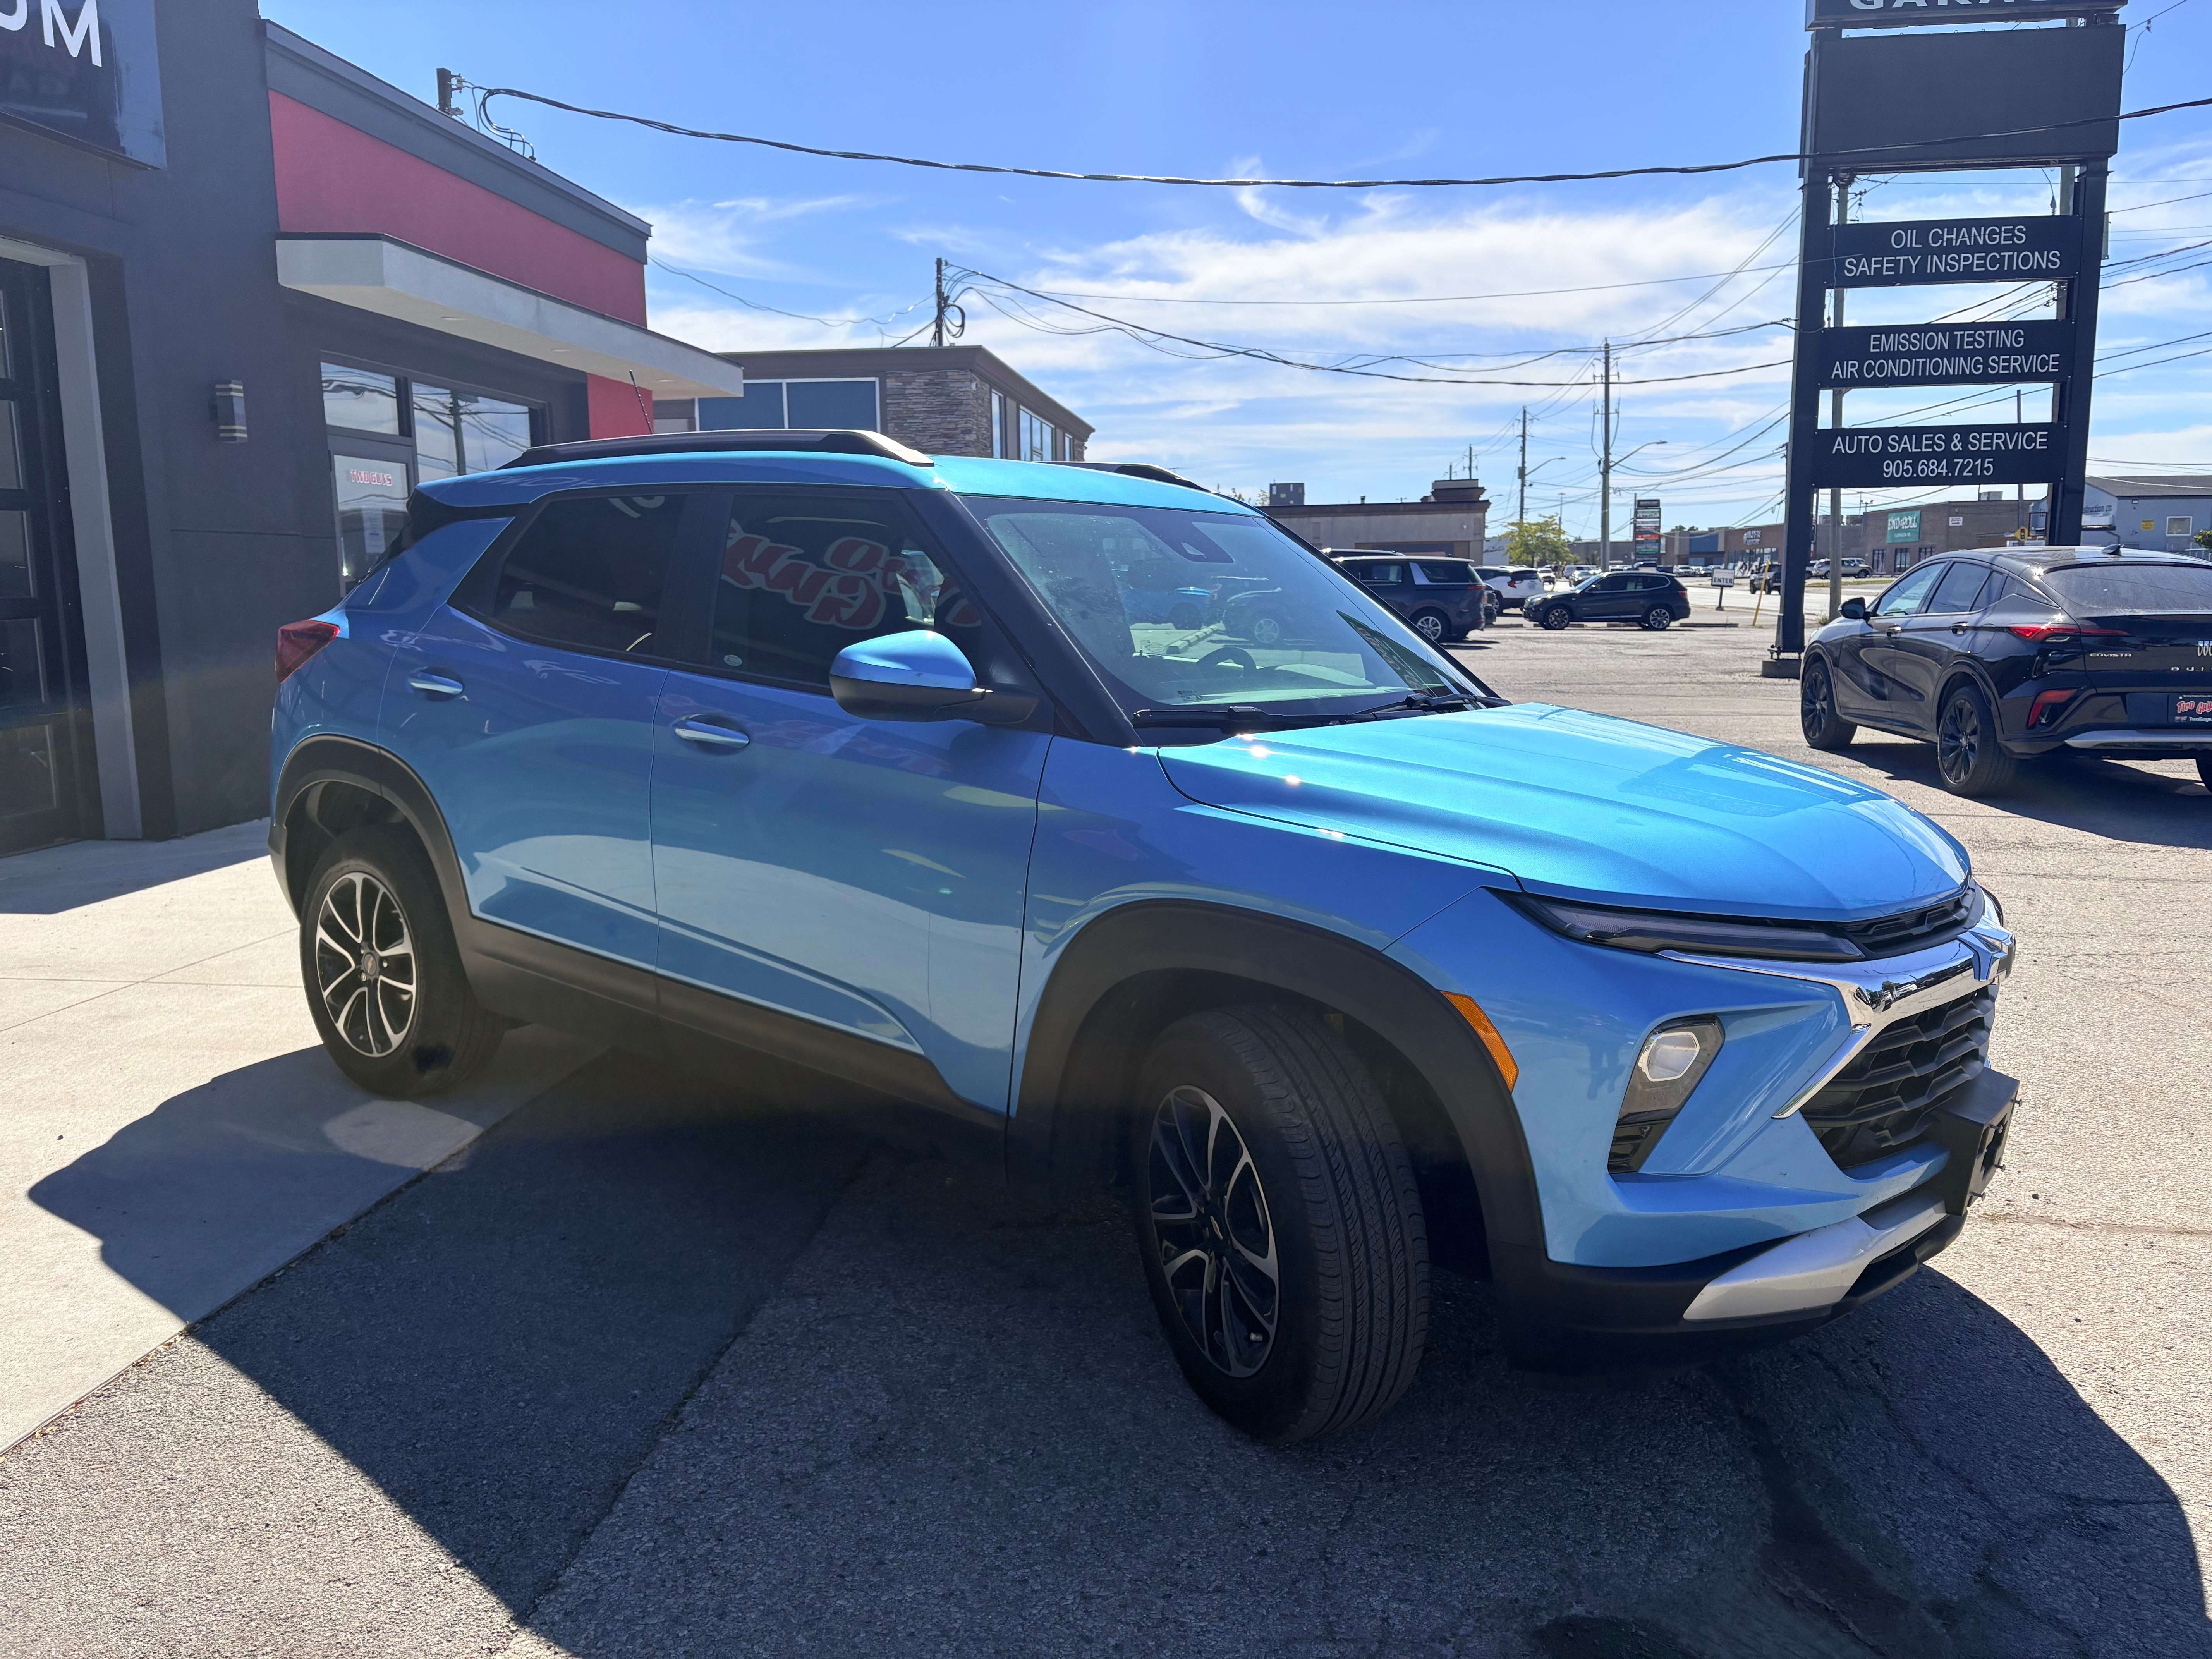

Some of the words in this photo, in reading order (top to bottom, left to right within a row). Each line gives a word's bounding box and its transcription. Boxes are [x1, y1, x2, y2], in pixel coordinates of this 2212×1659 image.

[1891, 230, 1922, 248] OIL
[1929, 225, 2026, 247] CHANGES
[1844, 255, 1921, 276] SAFETY
[1927, 251, 2061, 273] INSPECTIONS
[1870, 331, 1949, 352] EMISSION
[1954, 329, 2024, 349] TESTING
[1831, 360, 1859, 379] AIR
[1864, 357, 1983, 378] CONDITIONING
[1988, 354, 2060, 374] SERVICE
[1832, 435, 1882, 453] AUTO
[1887, 433, 1945, 452] SALES
[1951, 433, 1962, 451] &
[1968, 431, 2048, 450] SERVICE
[1883, 458, 1994, 478] 905.684.7215
